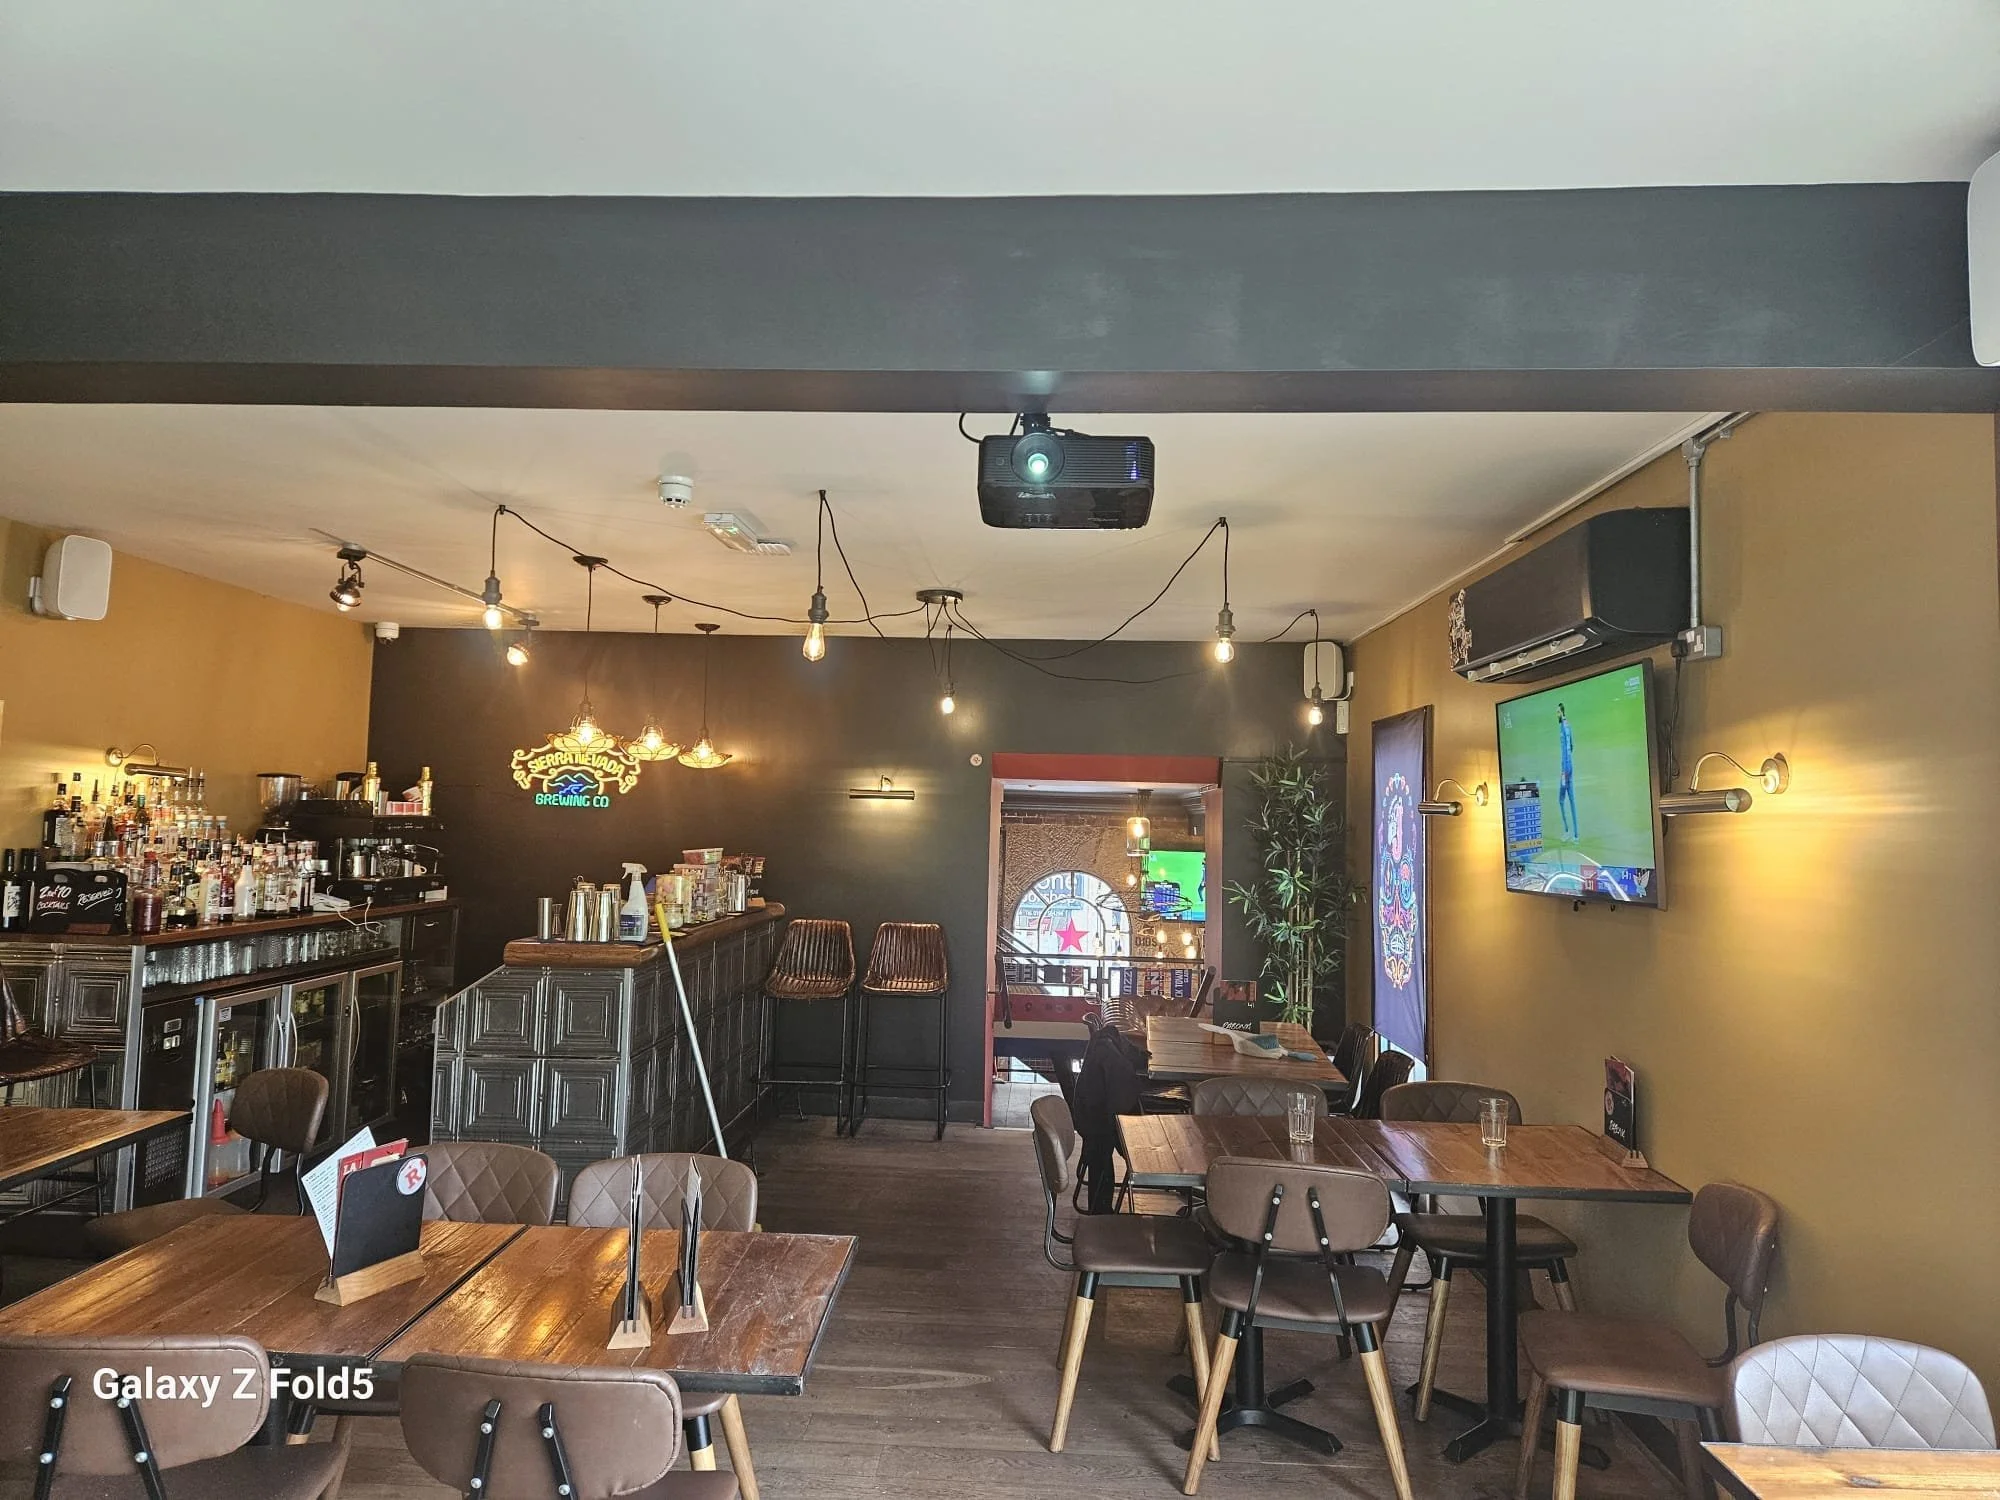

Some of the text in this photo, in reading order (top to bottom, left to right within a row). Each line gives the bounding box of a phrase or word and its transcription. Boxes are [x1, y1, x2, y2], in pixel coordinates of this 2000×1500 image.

[528, 752, 625, 777] SIERRA NEVADA
[535, 793, 610, 808] BREWING CO
